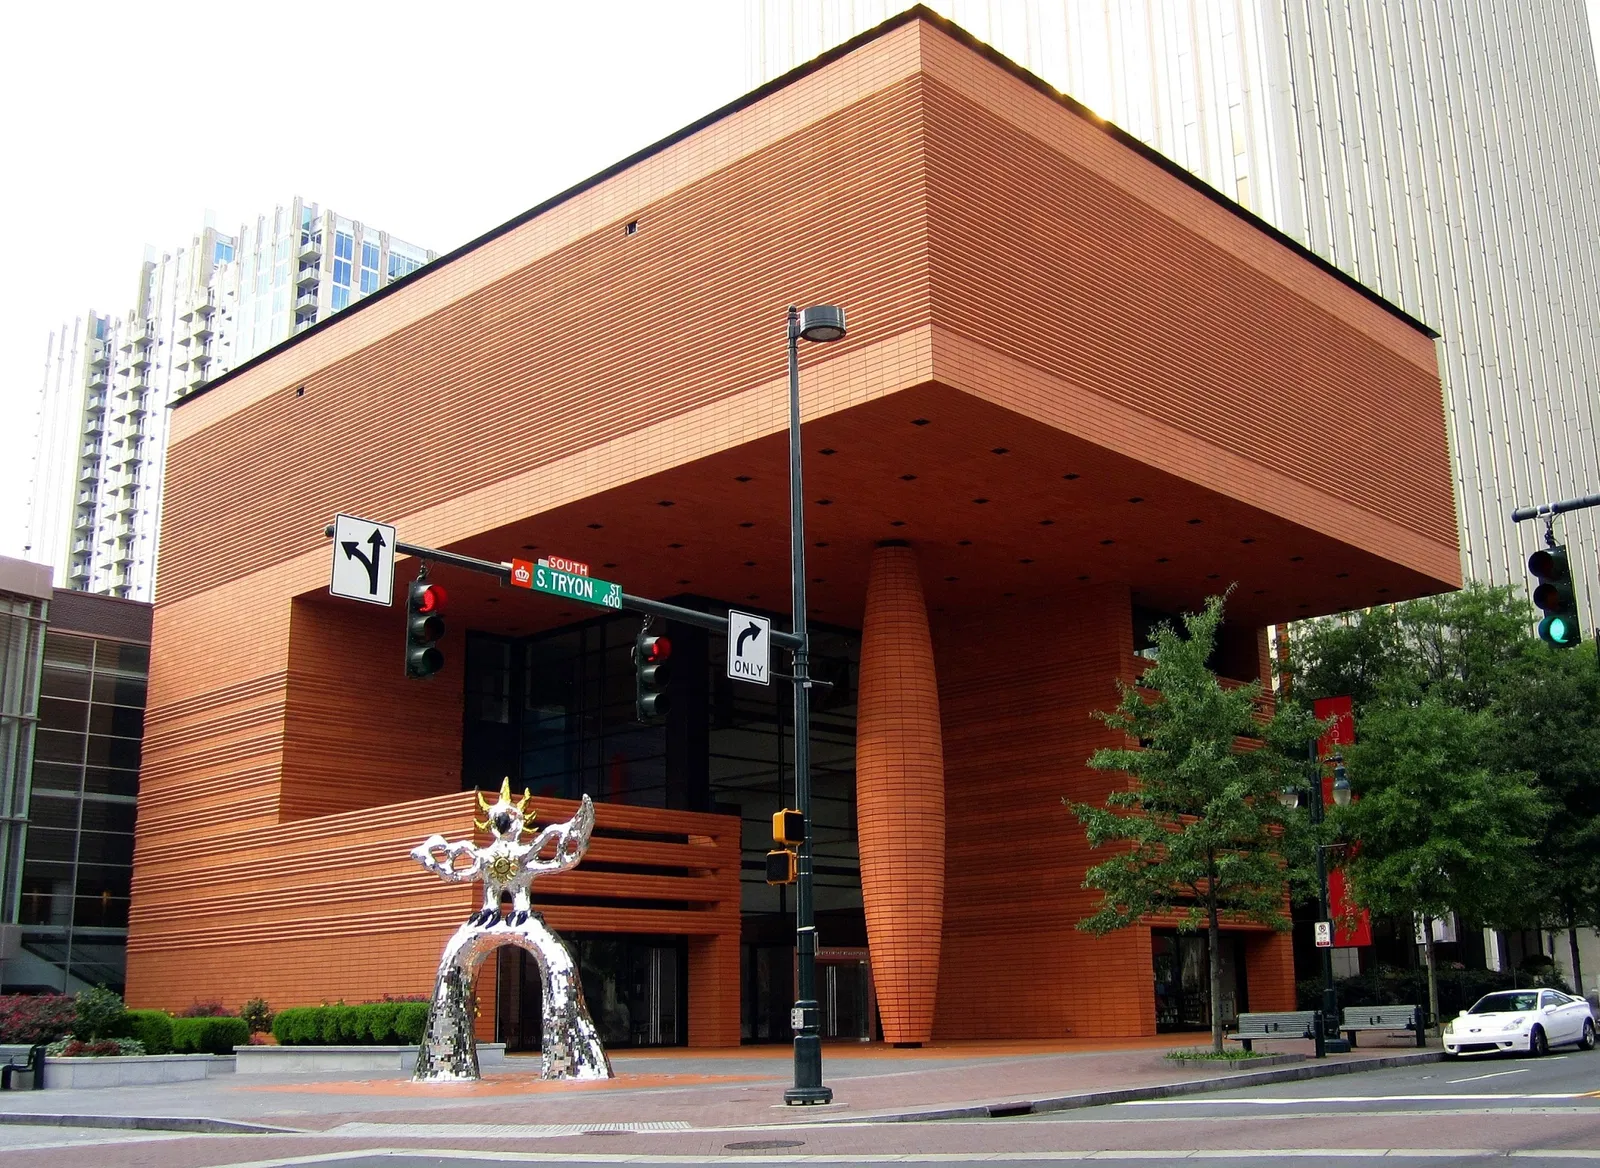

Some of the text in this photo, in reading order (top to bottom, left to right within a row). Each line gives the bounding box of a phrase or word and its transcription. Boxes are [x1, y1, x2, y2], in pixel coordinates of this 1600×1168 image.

[549, 557, 588, 576] SOUTH
[536, 569, 593, 599] S. TRYON
[609, 584, 620, 597] ST
[602, 594, 620, 608] 400
[734, 660, 764, 677] ONLY
